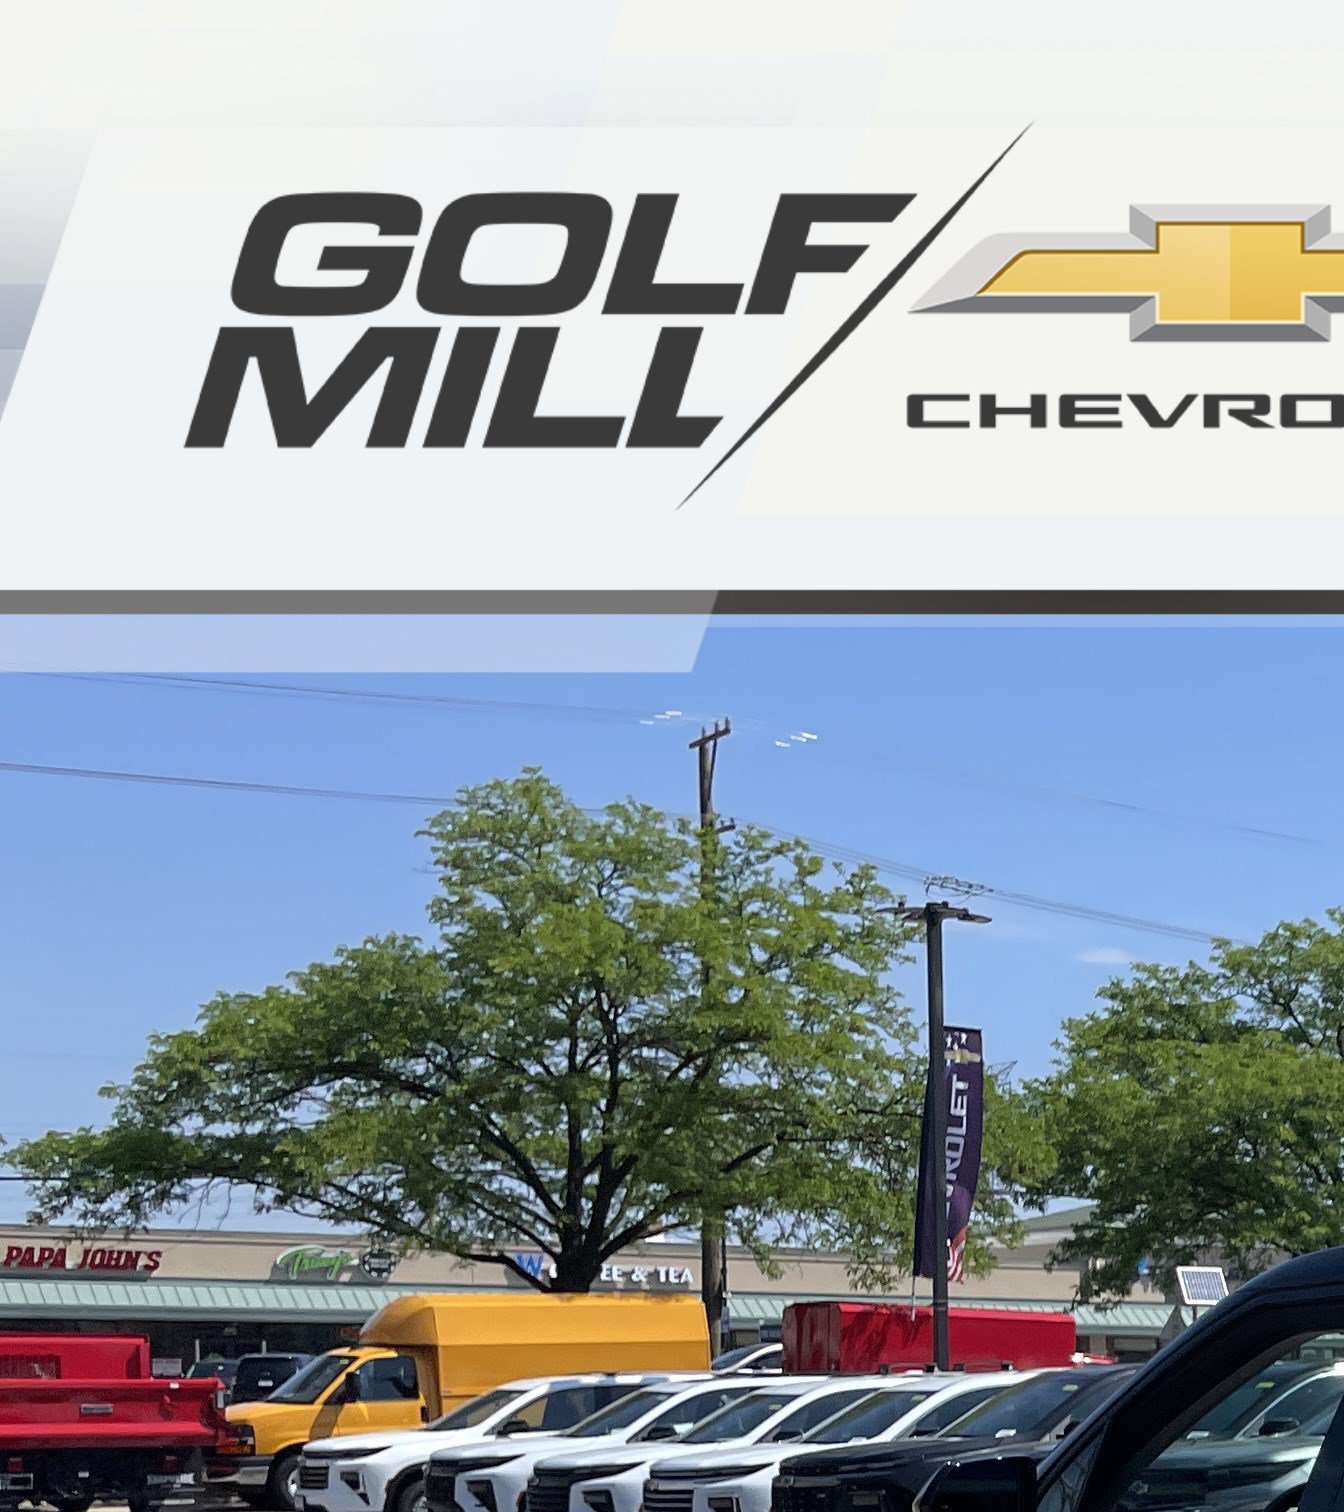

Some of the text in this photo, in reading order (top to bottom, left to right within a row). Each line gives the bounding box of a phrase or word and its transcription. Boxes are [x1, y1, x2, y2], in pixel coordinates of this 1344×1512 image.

[3, 1246, 163, 1272] PAPA JOHN'S
[656, 1264, 694, 1284] TEA
